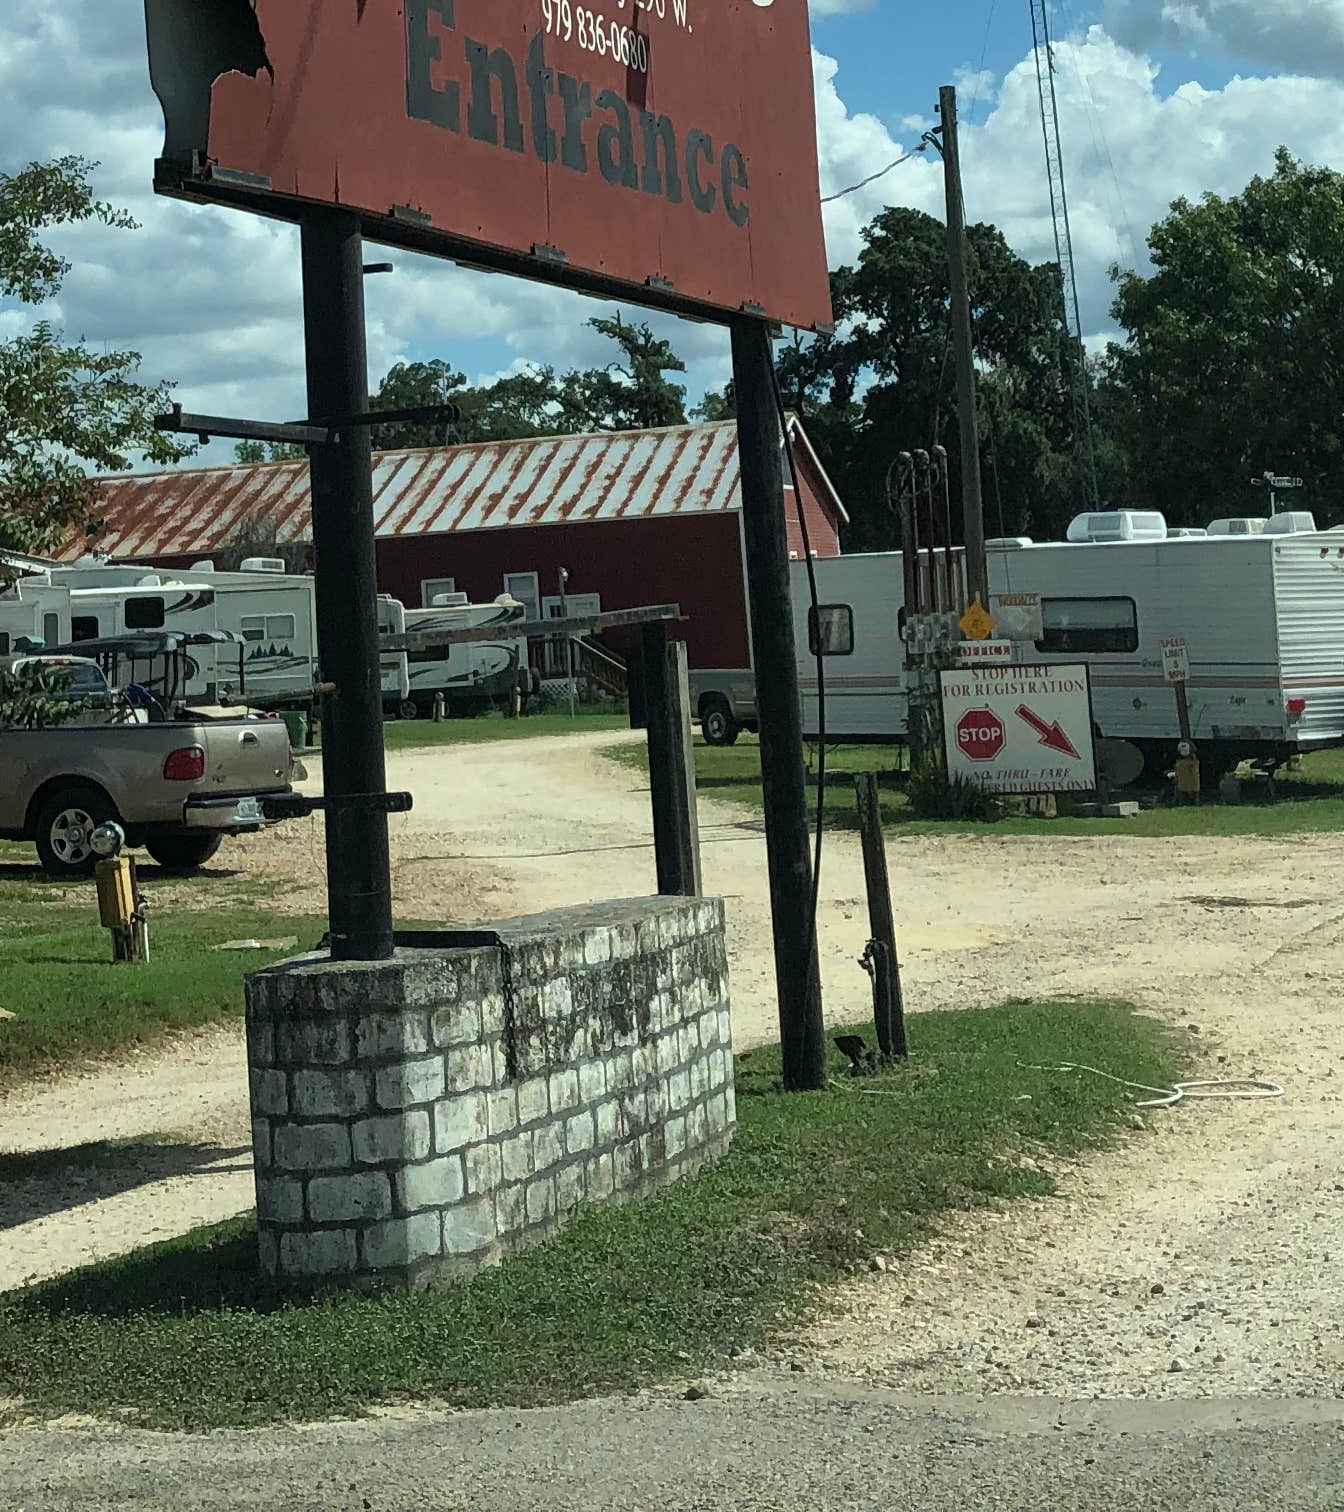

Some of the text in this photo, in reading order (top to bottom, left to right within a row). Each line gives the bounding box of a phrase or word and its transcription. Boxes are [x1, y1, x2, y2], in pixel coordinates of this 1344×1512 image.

[576, 5, 647, 73] 836-0680
[972, 668, 1008, 681] STOP
[943, 678, 1085, 696] FOR REGISTRATION
[959, 727, 1001, 742] STOP
